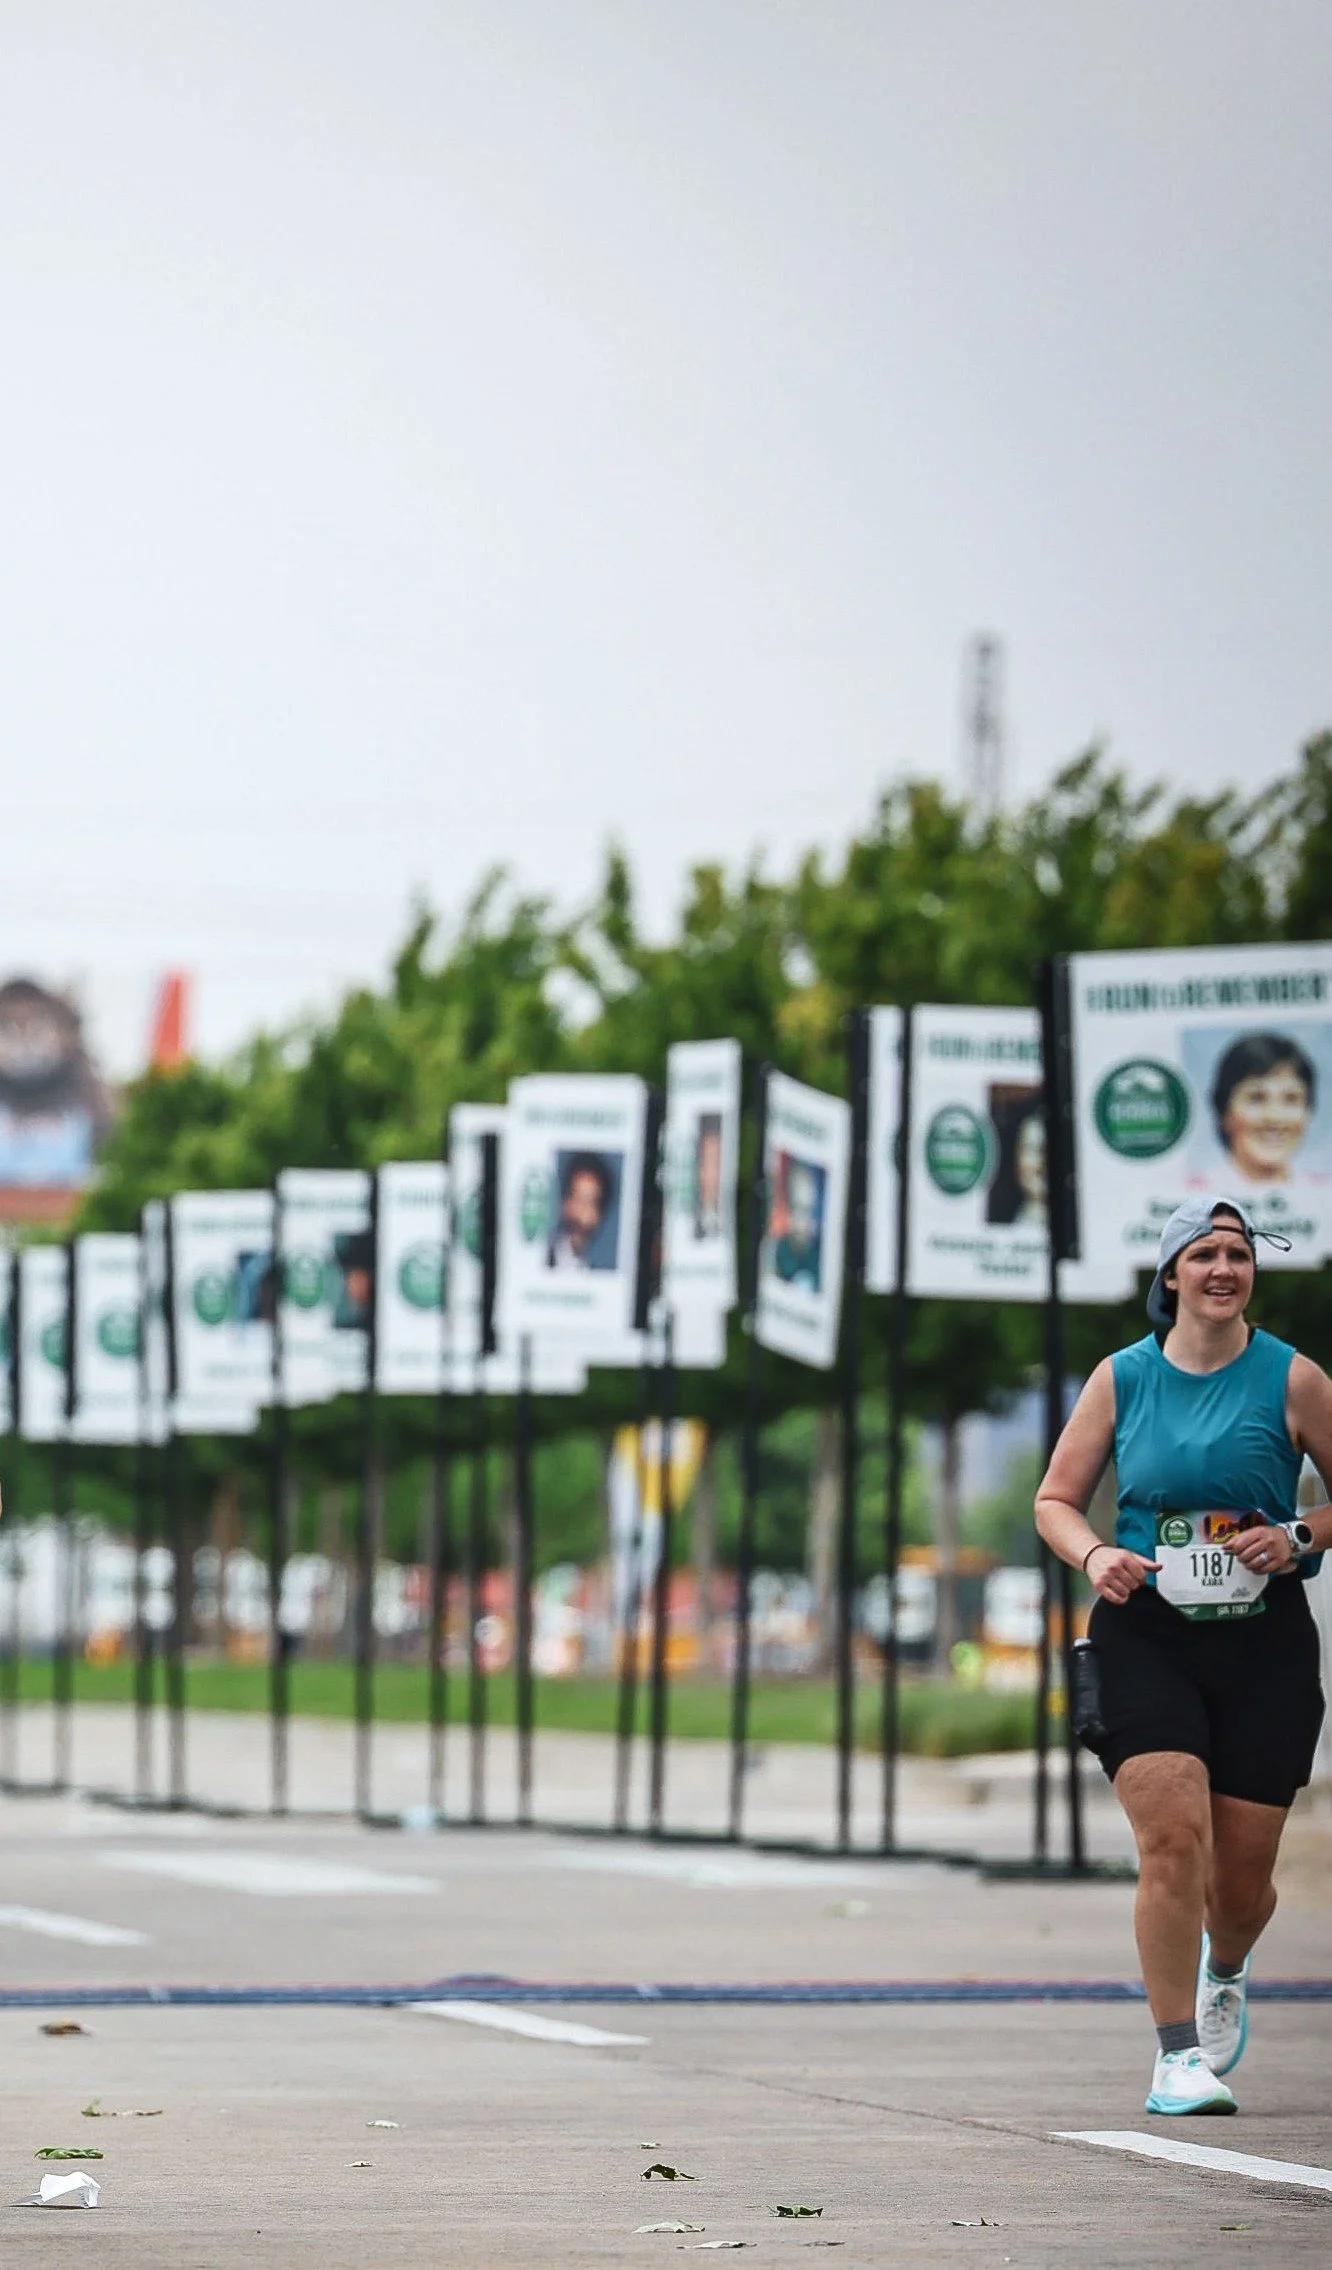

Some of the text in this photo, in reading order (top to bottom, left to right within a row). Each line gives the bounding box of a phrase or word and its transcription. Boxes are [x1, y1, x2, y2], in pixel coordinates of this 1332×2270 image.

[1100, 982, 1158, 1010] RUN
[1179, 971, 1327, 1007] REMEMBER
[1191, 1552, 1234, 1577] 1187
